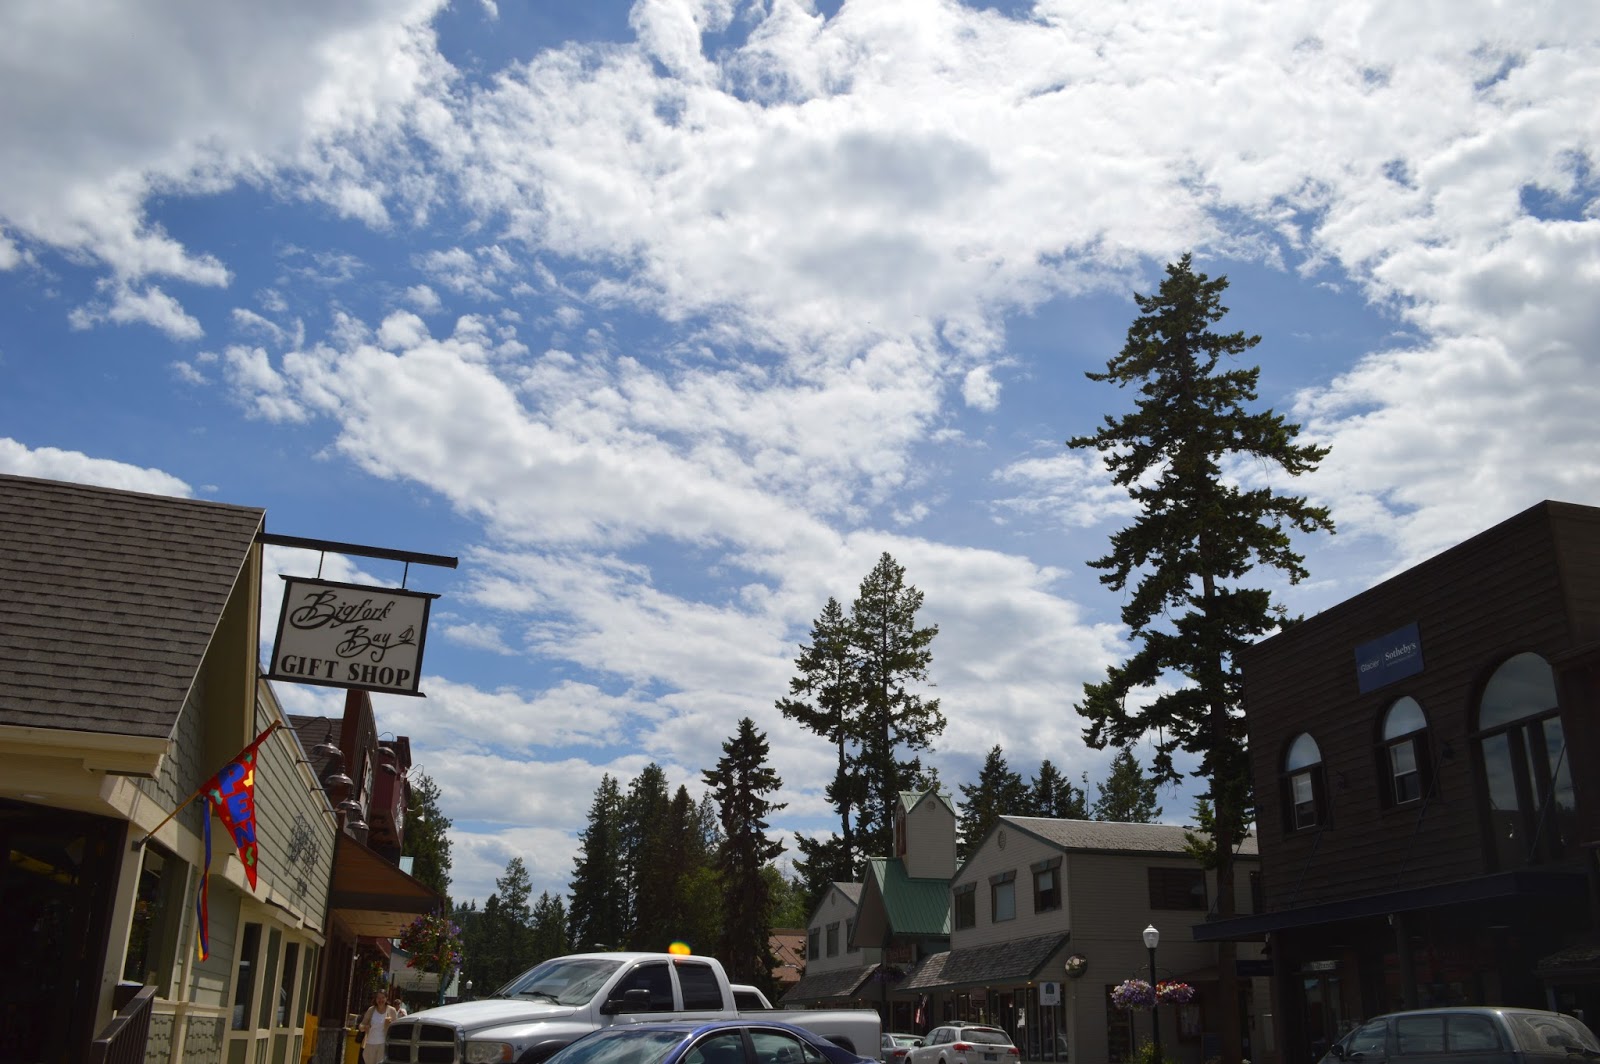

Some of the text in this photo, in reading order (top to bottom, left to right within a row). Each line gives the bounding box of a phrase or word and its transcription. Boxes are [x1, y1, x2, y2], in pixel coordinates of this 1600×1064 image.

[290, 590, 396, 629] Bigfork
[336, 625, 392, 663] Bay
[281, 654, 411, 687] GIFT SHOP
